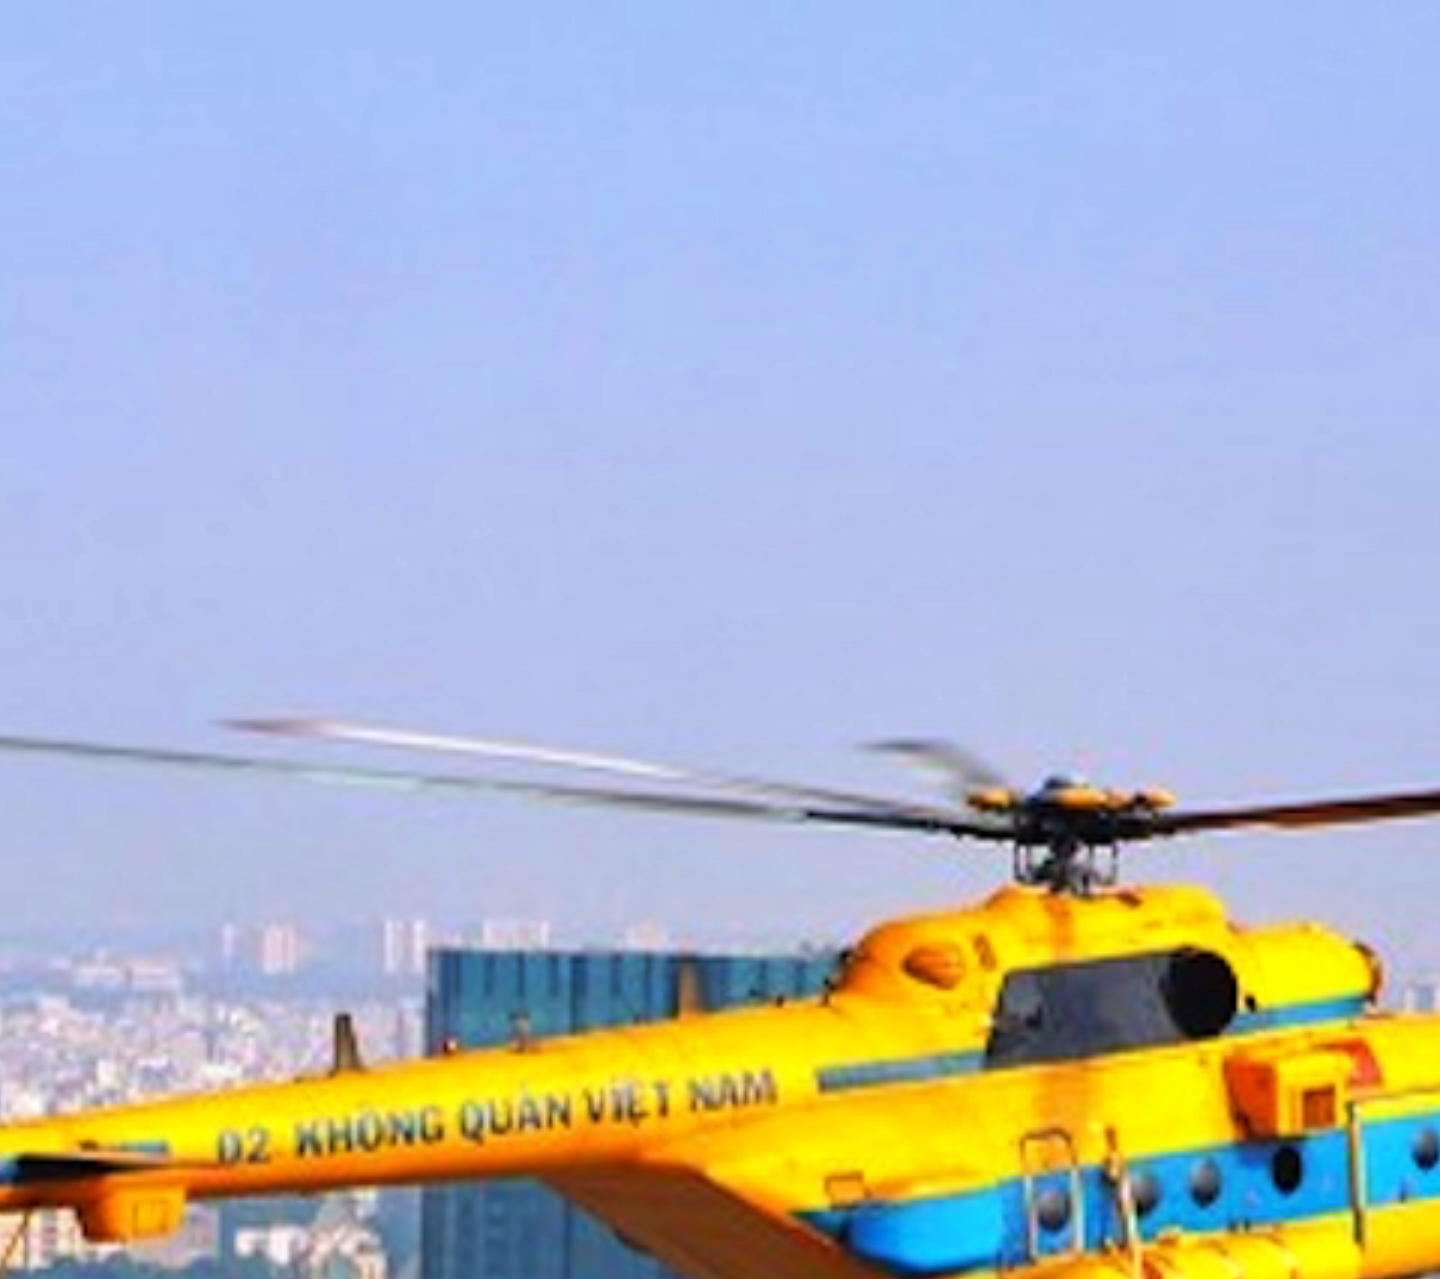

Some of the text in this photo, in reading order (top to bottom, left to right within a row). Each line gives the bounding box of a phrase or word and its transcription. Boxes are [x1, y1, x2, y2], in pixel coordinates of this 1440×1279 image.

[294, 1103, 445, 1158] KHÔNG
[458, 1085, 572, 1145] QUÂN
[582, 1076, 670, 1127] VIỆT
[687, 1067, 779, 1113] NAM
